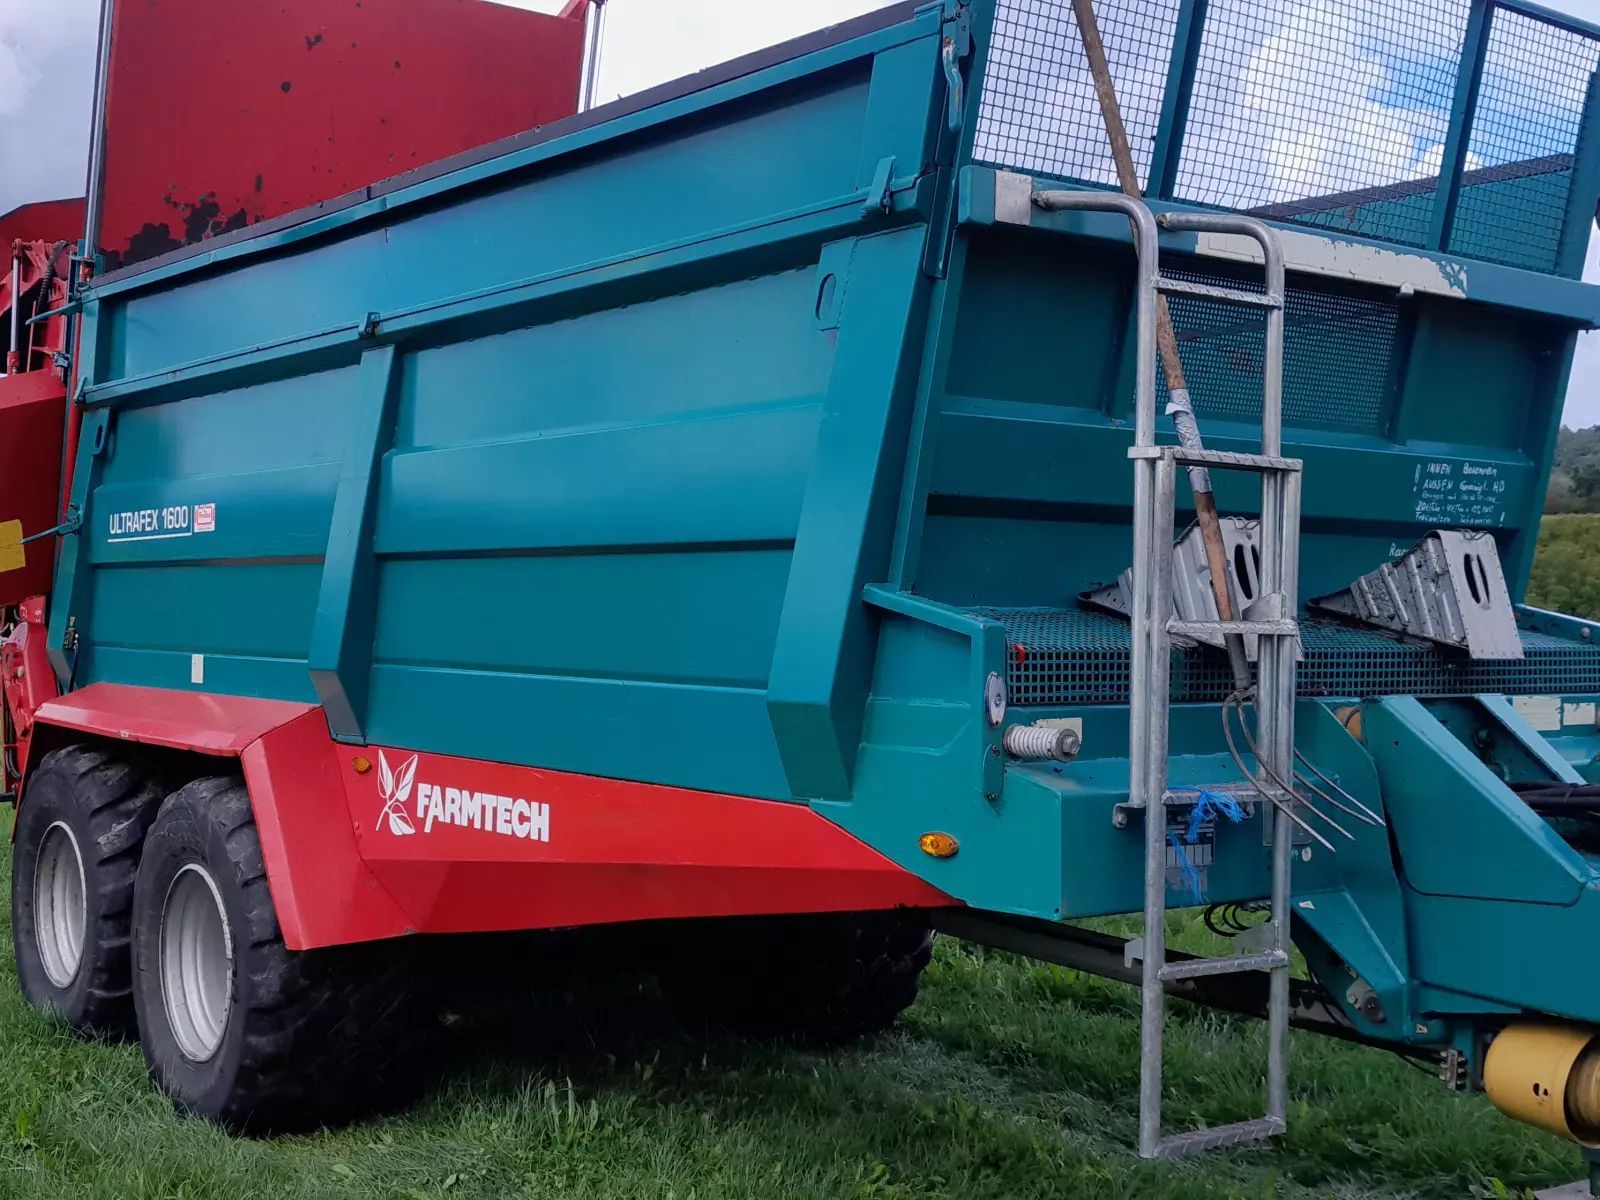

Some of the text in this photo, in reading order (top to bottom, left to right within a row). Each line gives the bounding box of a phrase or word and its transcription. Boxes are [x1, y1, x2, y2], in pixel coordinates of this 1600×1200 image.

[1426, 462, 1452, 475] INNEN
[1422, 478, 1454, 491] AUSSEN
[109, 509, 159, 535] ULTRAFEX
[162, 505, 189, 530] 1600
[416, 782, 550, 843] FARMTECH
